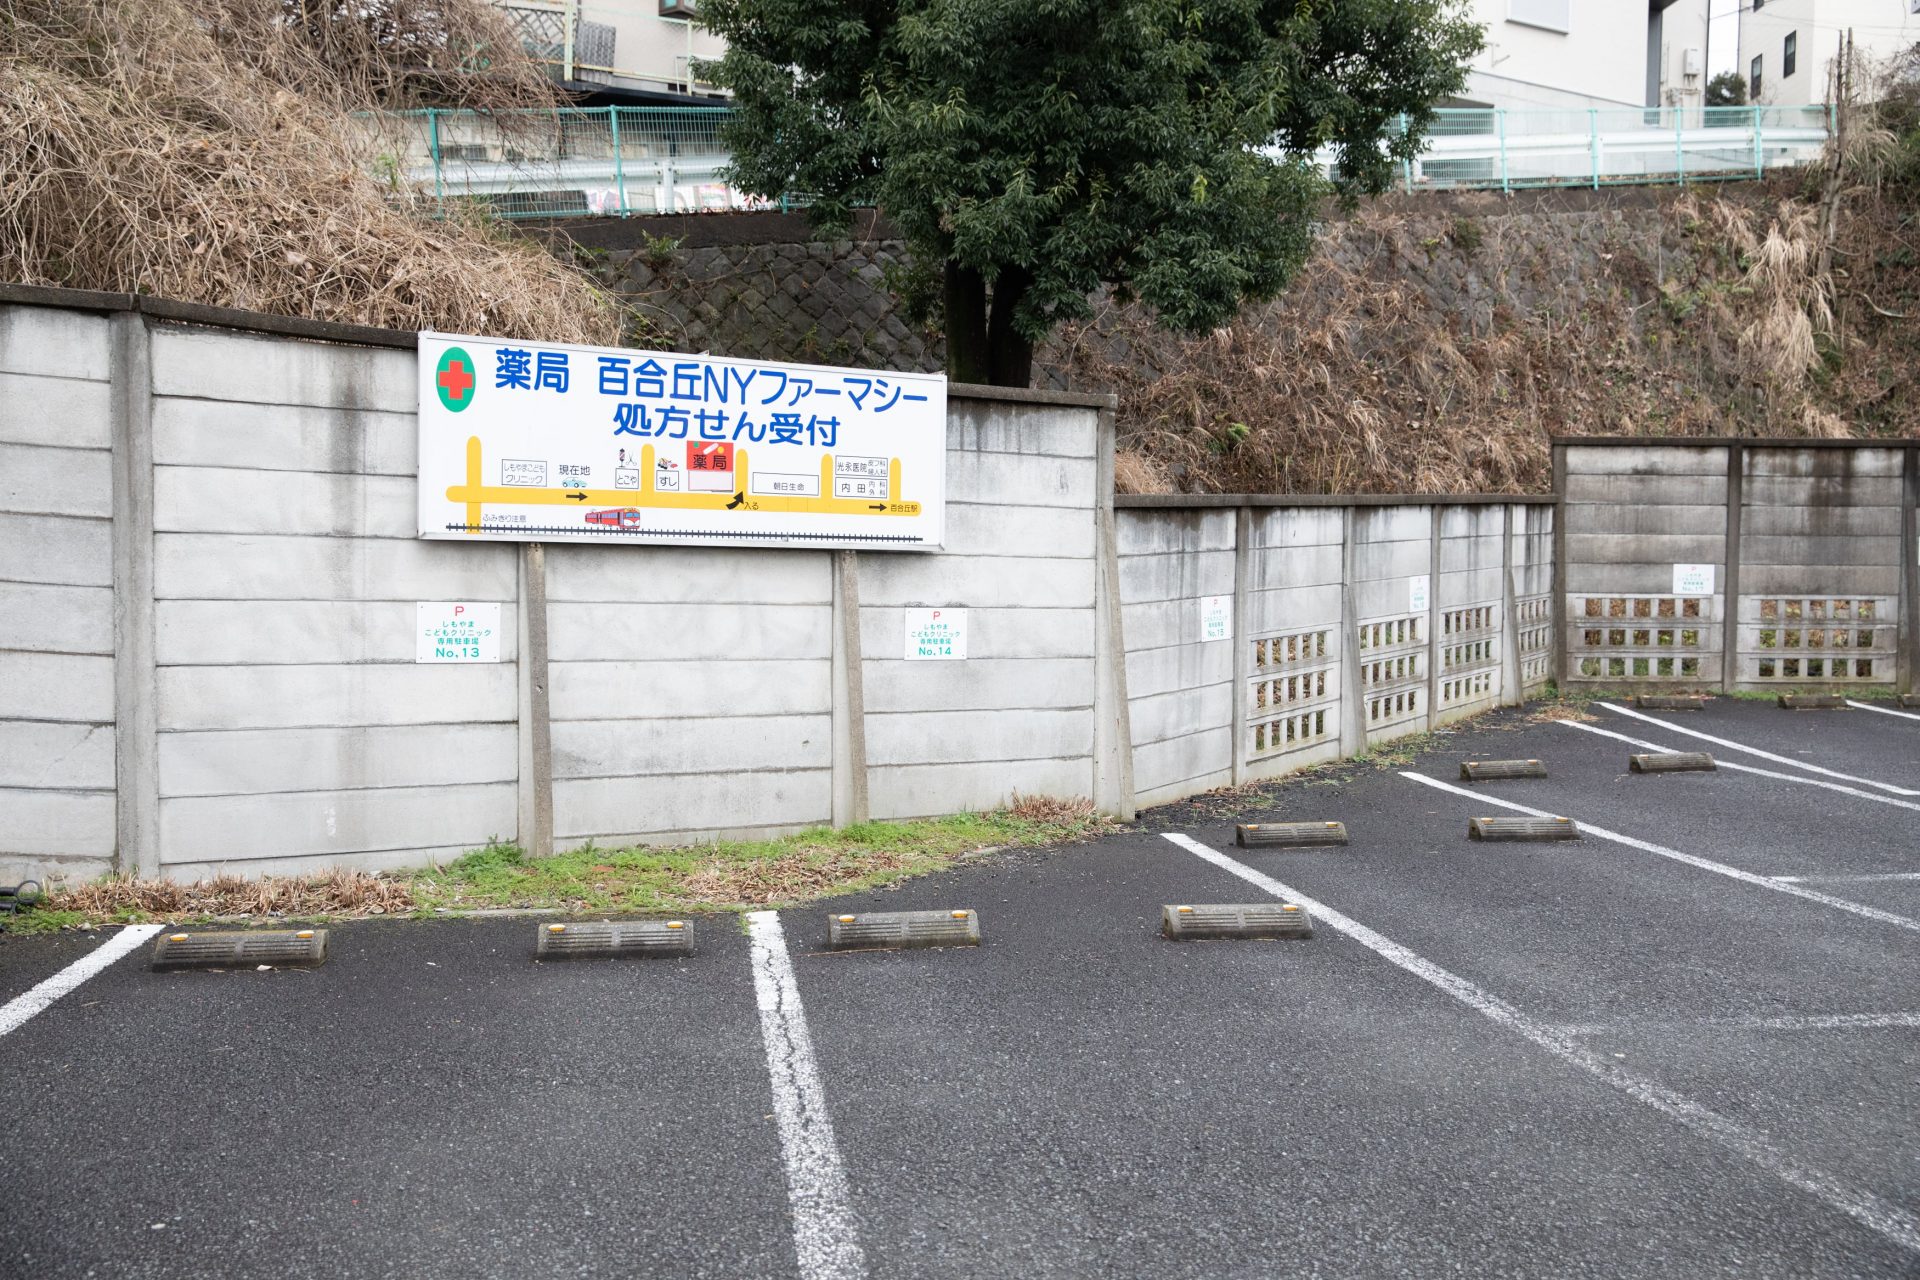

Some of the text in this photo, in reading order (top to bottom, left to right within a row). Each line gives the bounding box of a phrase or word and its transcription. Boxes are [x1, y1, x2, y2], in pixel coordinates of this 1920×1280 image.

[495, 349, 928, 413] 薬局 百合丘NYファーマシー
[613, 403, 841, 448] 処方せん受付
[693, 454, 727, 470] 薬局
[837, 461, 867, 473] 光永医院
[559, 464, 591, 476] 現在地
[505, 475, 544, 484] クリニック
[617, 475, 638, 486] とこや
[659, 476, 678, 487] すし
[773, 482, 805, 491] 朝日生命
[842, 483, 866, 493] 内田
[744, 502, 759, 511] 入る
[890, 504, 918, 513] 百合丘駅
[482, 514, 527, 523] ふみきり注意
[455, 606, 465, 616] P
[933, 611, 941, 620] P
[424, 629, 492, 637] こどもクリニック
[437, 637, 479, 645] 専用駐車場
[435, 647, 480, 658] No.13
[918, 647, 952, 656] No.14
